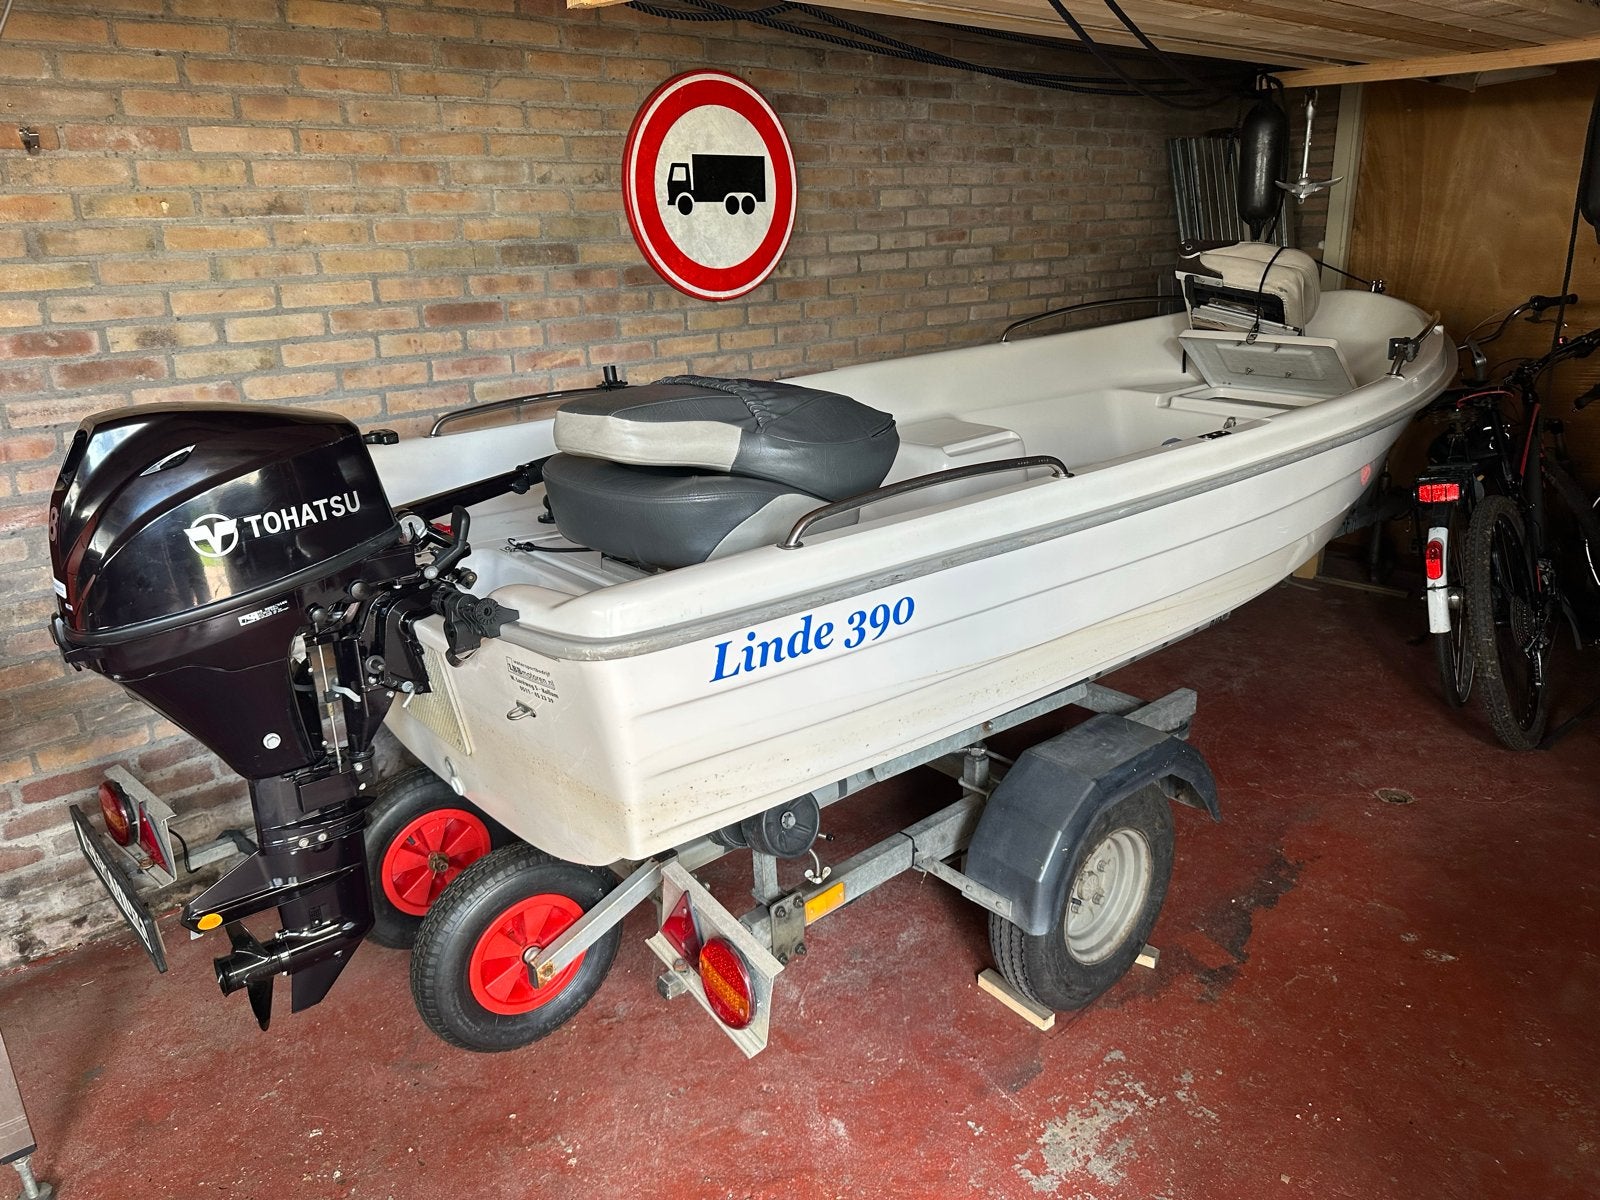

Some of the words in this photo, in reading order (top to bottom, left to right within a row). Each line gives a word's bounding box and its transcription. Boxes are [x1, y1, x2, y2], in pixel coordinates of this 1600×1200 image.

[244, 491, 361, 538] TOHATSU
[709, 614, 834, 682] Linde
[844, 596, 915, 649] 390
